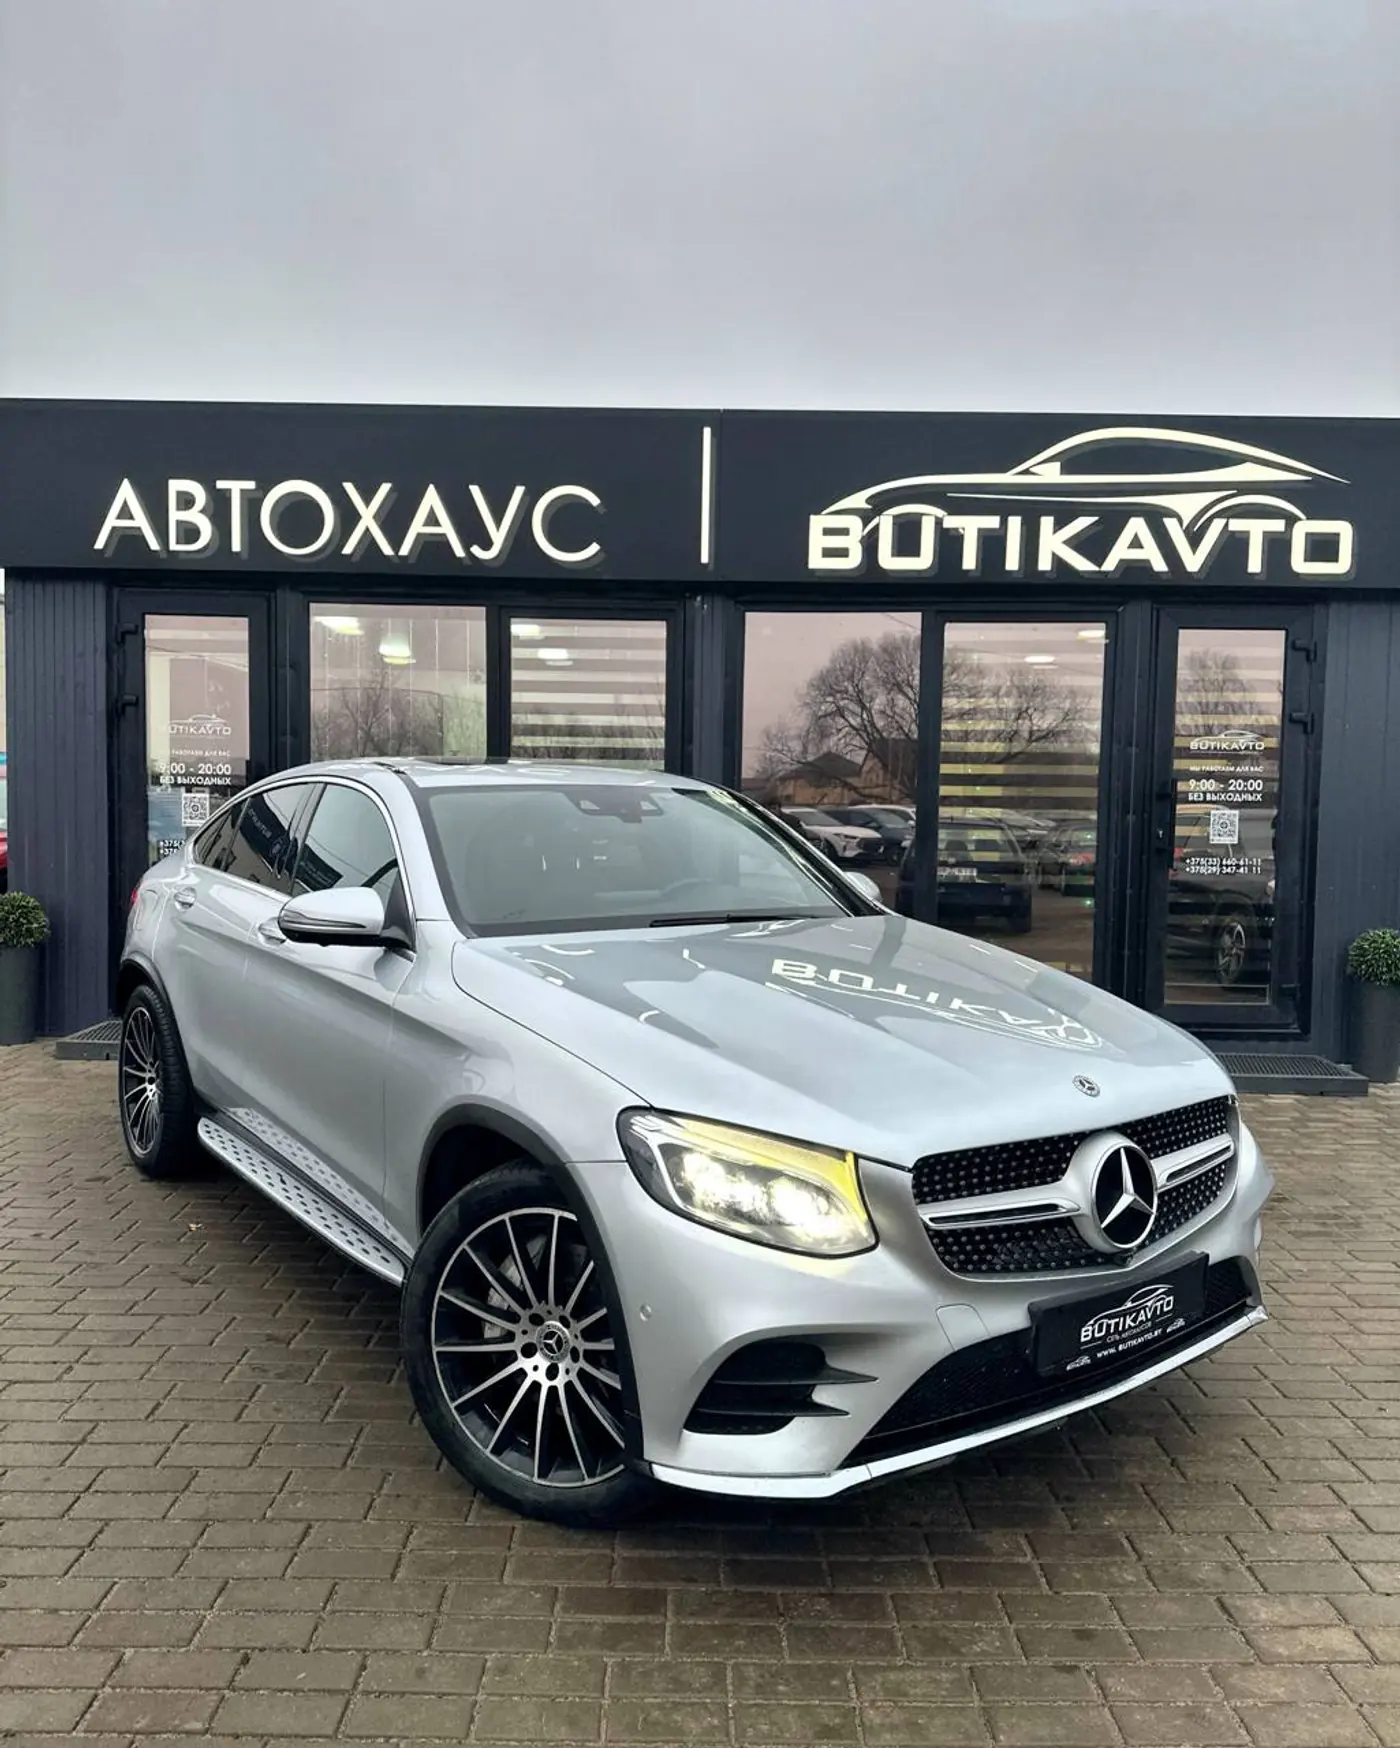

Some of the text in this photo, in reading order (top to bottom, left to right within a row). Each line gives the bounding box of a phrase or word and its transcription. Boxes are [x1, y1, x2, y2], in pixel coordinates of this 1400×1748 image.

[93, 478, 602, 562] АВТОХАУС
[808, 513, 1354, 575] BUTIKAVTO
[158, 723, 232, 736] UTIKAVTO
[1189, 740, 1265, 751] BUTIKAVTO
[198, 763, 232, 775] 20:00
[159, 776, 232, 786] БЕЗ ВЫХОДНЫХ
[1188, 778, 1216, 791] 9:00
[1228, 779, 1263, 791] 20:00
[1188, 792, 1262, 802] БЕЗ ВЫХОДНЫХ
[1080, 1295, 1174, 1343] BUTIKAVTO
